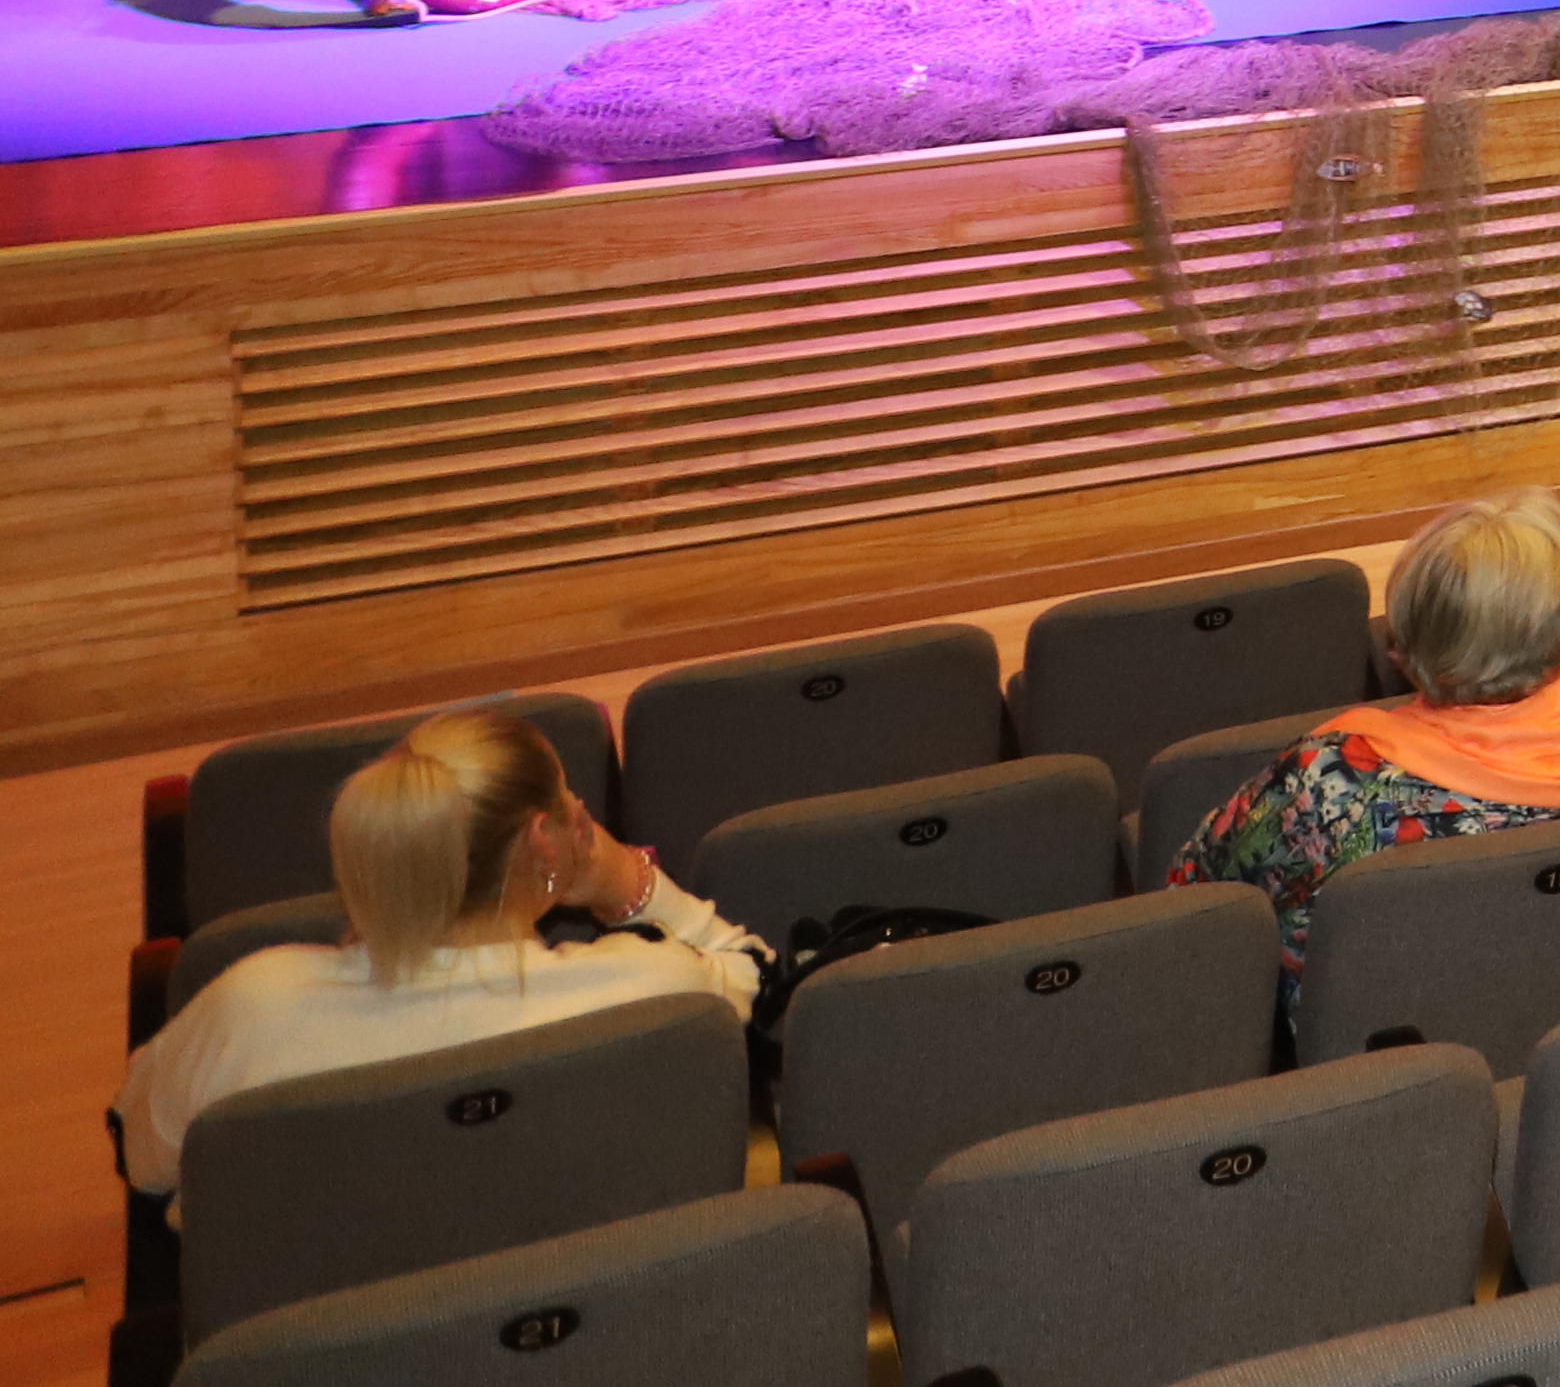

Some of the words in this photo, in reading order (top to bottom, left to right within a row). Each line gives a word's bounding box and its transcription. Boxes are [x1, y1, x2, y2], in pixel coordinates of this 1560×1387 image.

[1203, 611, 1226, 627] 19
[810, 680, 836, 697] 20
[909, 823, 938, 843] 20
[1035, 967, 1070, 991] 20
[463, 1096, 496, 1120] 21
[1211, 1152, 1253, 1180] 20
[518, 1315, 561, 1346] 21
